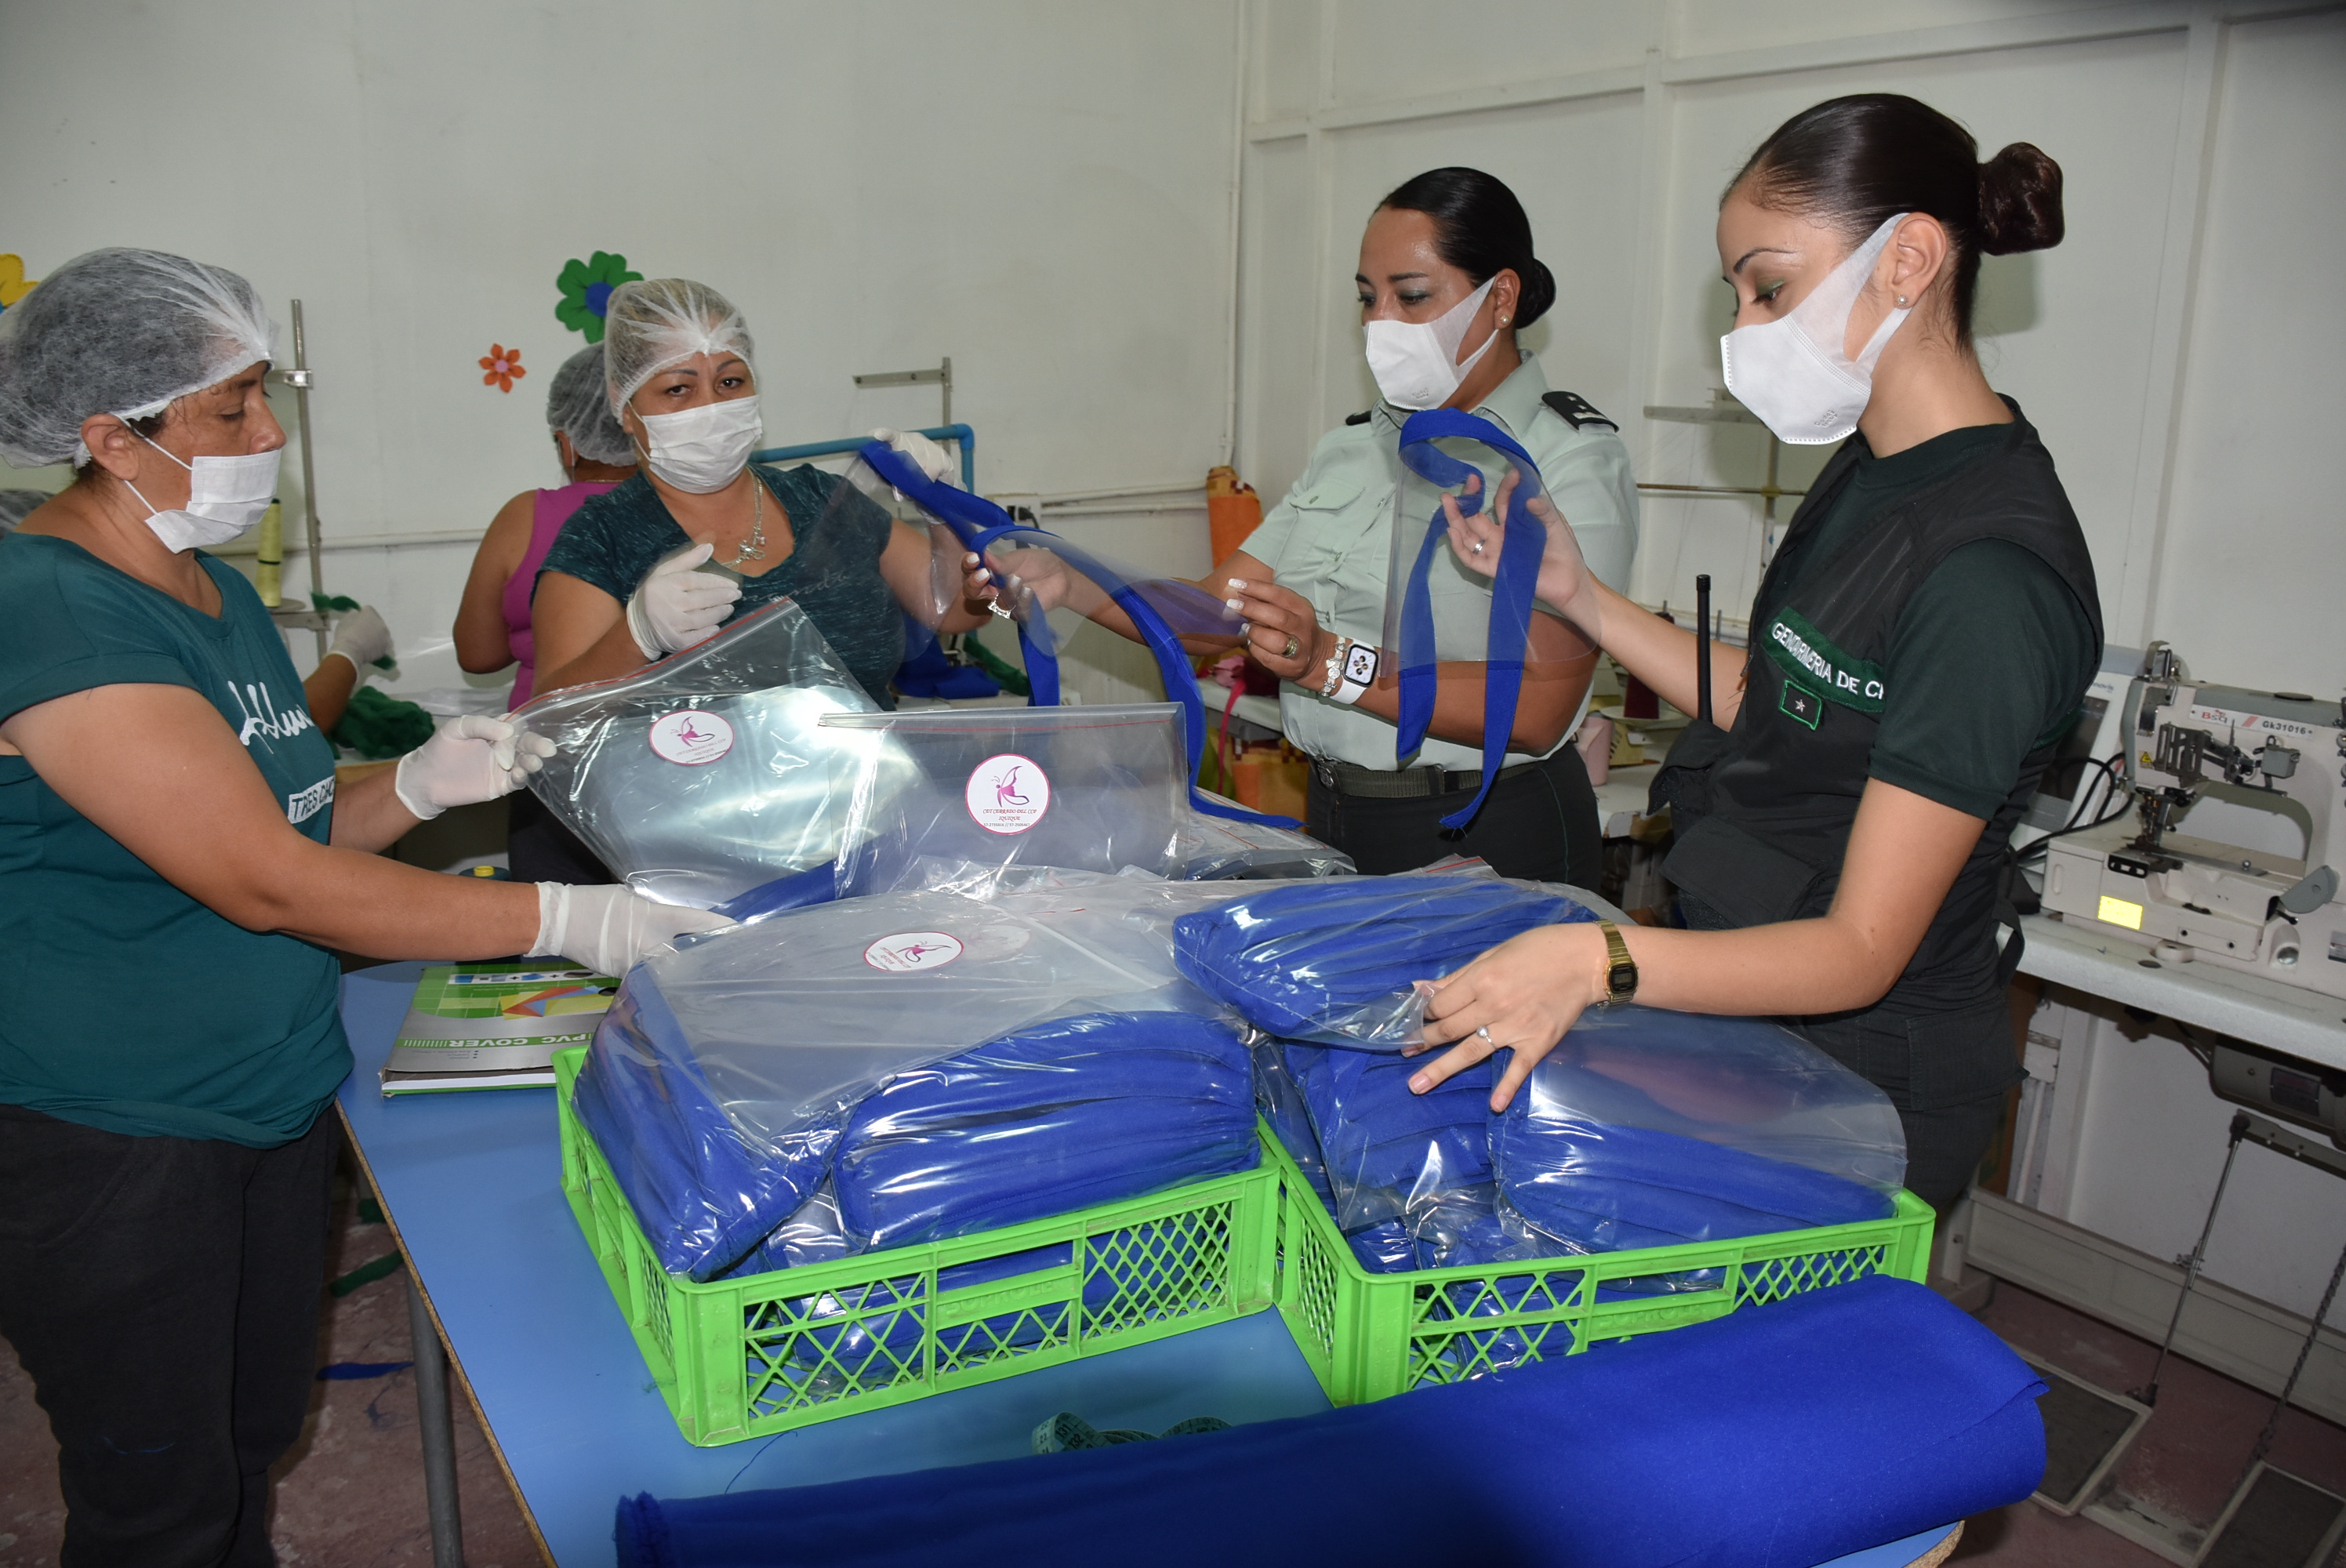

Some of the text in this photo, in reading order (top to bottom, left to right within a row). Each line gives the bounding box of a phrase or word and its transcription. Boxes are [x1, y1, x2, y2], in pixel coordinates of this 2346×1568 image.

[1836, 670, 1861, 695] DE
[292, 789, 318, 820] TRES
[448, 1033, 589, 1047] PVC COVER
[1055, 1424, 1072, 1439] 131
[1068, 1433, 1084, 1449] 132
